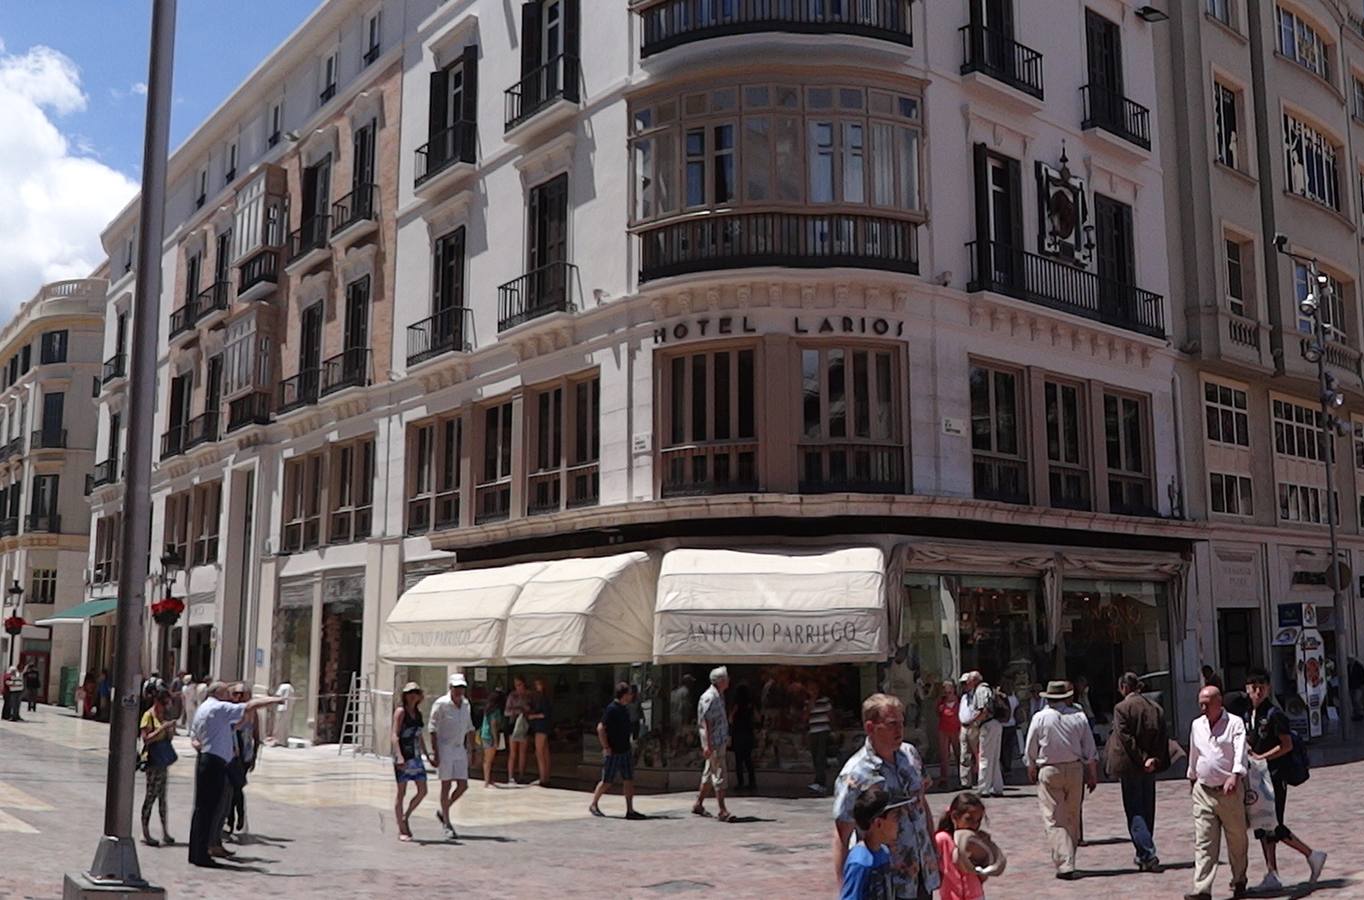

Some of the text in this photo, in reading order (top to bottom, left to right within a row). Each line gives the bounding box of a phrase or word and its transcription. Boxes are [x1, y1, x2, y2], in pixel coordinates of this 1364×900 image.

[653, 316, 904, 344] HOTEL LARIOS
[687, 622, 765, 644] ANTONIO
